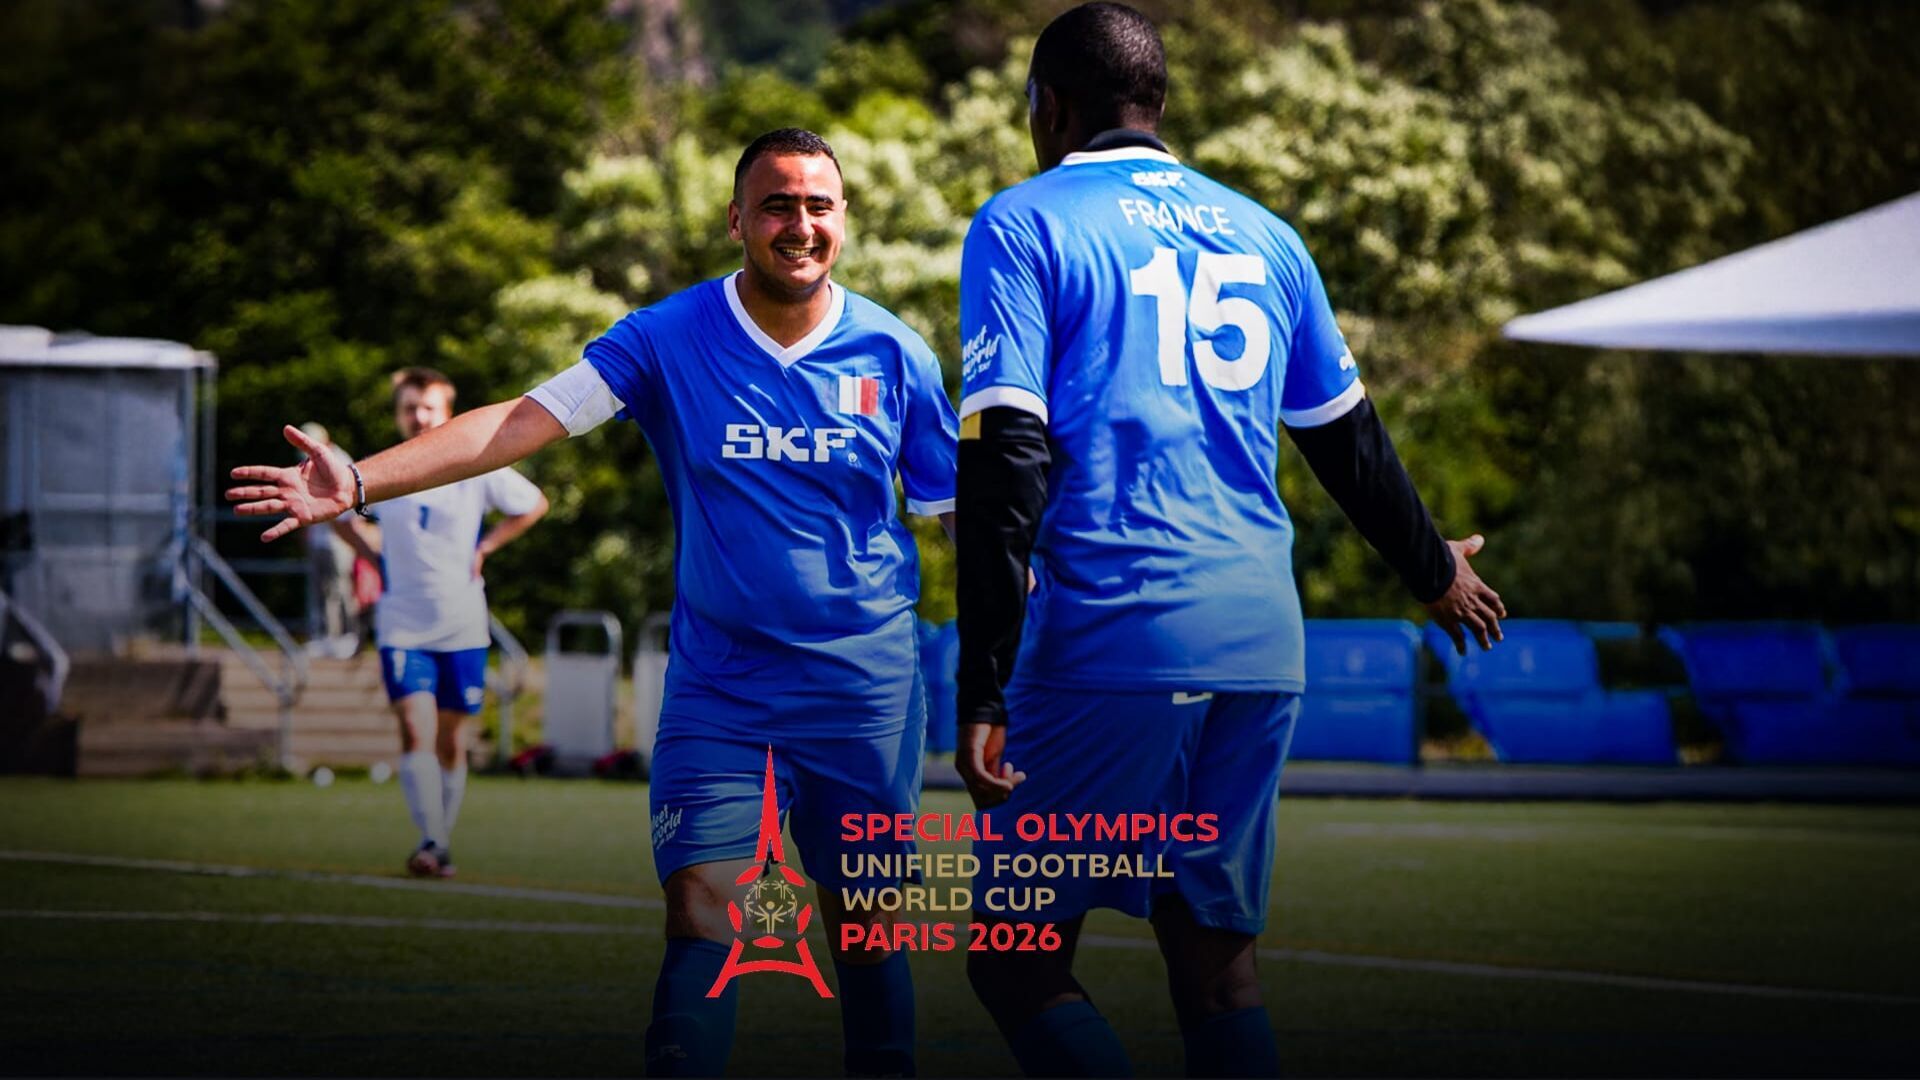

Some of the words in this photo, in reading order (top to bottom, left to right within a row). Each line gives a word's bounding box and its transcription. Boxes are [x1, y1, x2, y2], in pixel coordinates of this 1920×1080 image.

[1118, 199, 1236, 236] FRANCE
[1130, 246, 1271, 392] 15
[722, 423, 857, 463] SKF
